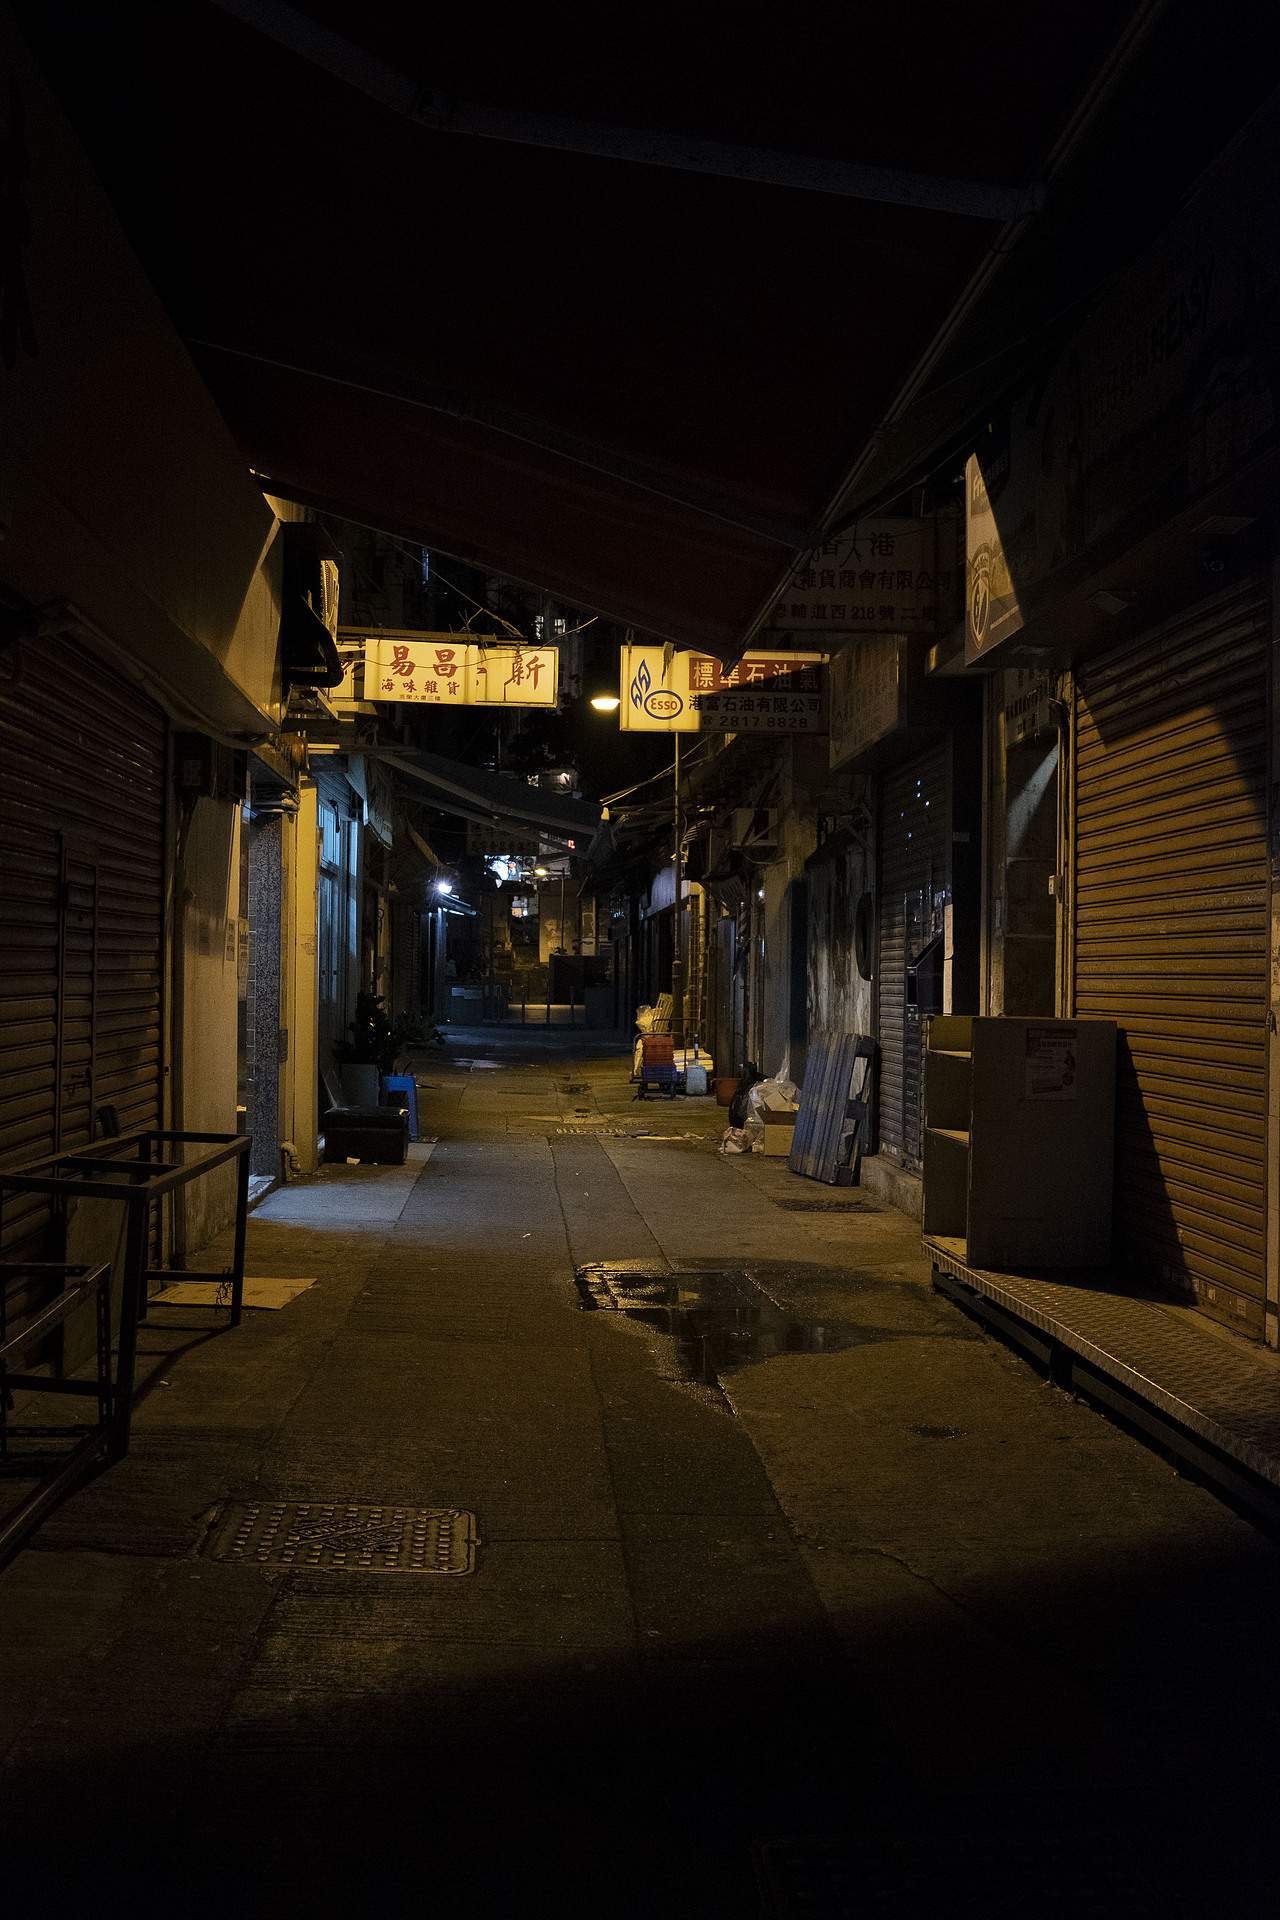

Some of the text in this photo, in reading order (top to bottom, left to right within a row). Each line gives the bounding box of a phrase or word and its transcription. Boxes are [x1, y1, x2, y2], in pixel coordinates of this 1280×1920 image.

[792, 569, 951, 591] 雜貨商會有限公司
[381, 678, 461, 696] 海味雜貨
[688, 694, 822, 714] 港富石油有限公司
[719, 716, 808, 729] 2817 8828
